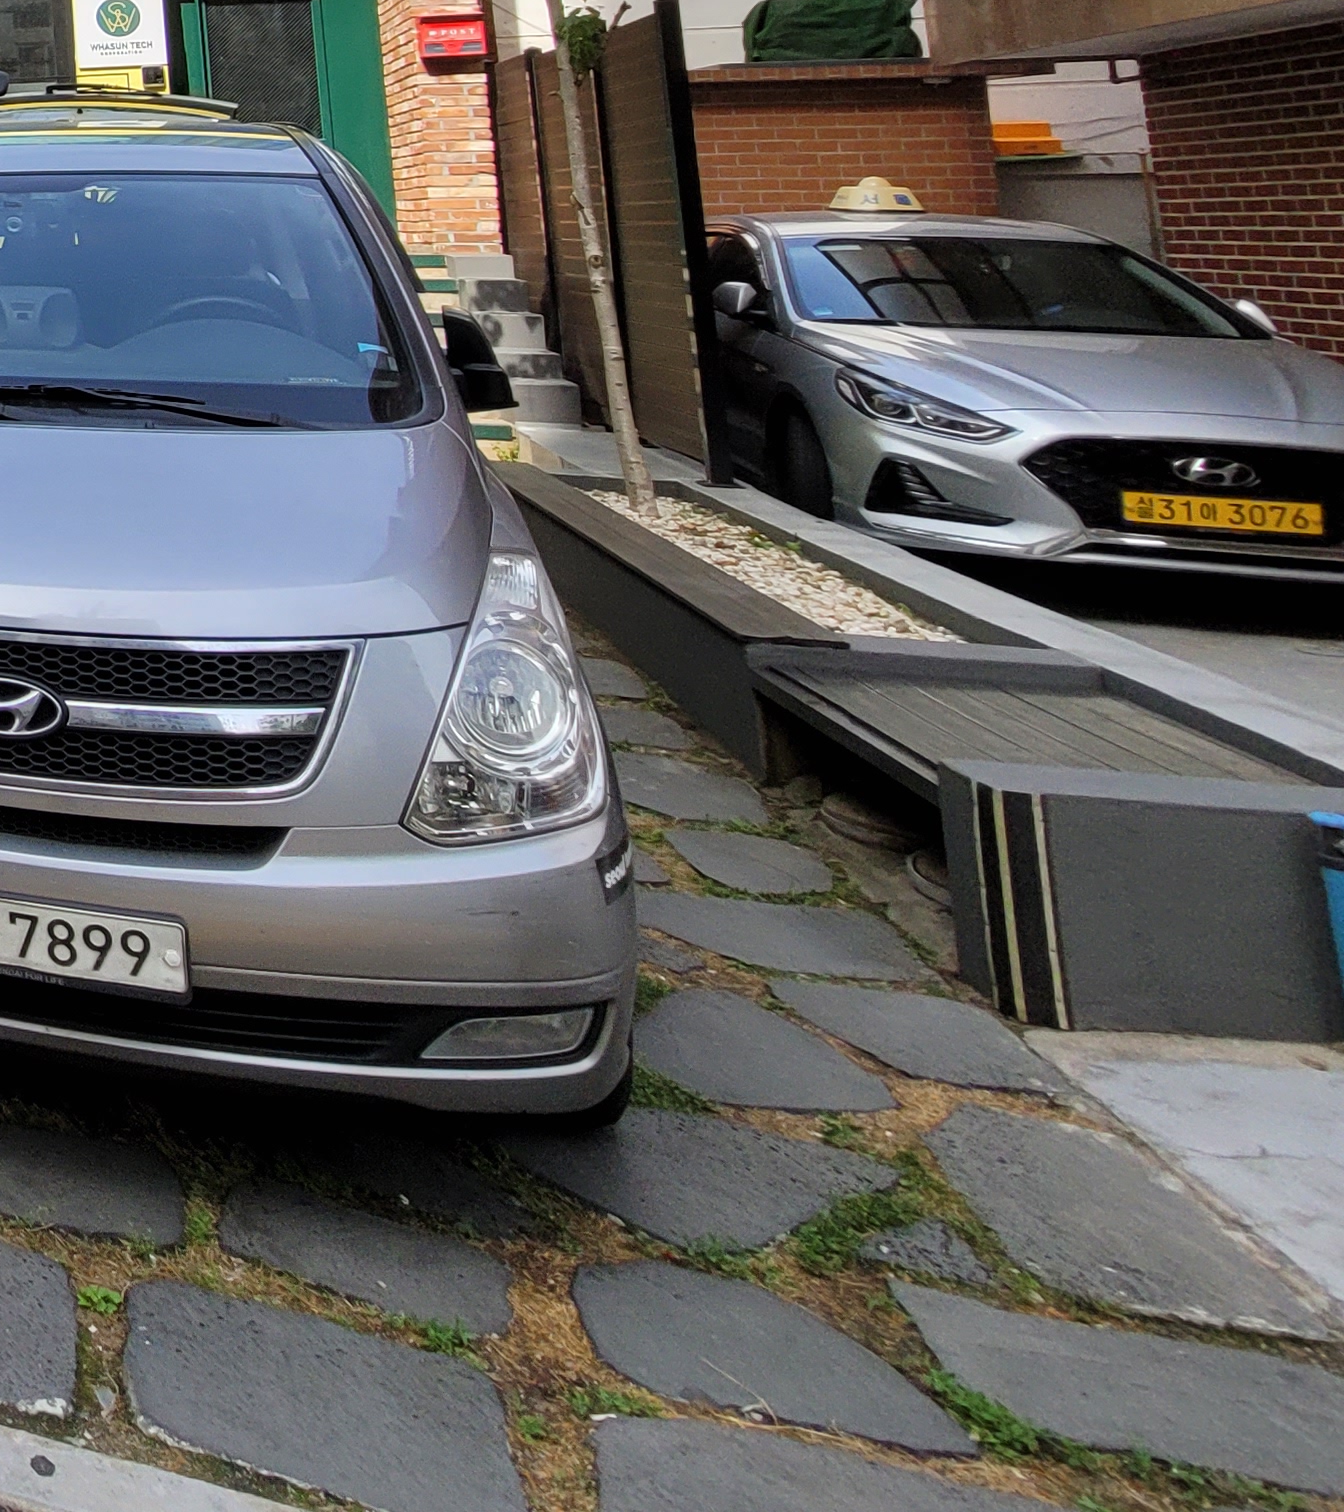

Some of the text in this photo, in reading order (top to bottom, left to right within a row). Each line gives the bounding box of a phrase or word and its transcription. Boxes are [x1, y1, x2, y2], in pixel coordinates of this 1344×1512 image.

[440, 28, 475, 36] POST
[89, 40, 153, 52] WHASUN TECH
[1228, 503, 1310, 530] 3076
[9, 912, 151, 977] 7899
